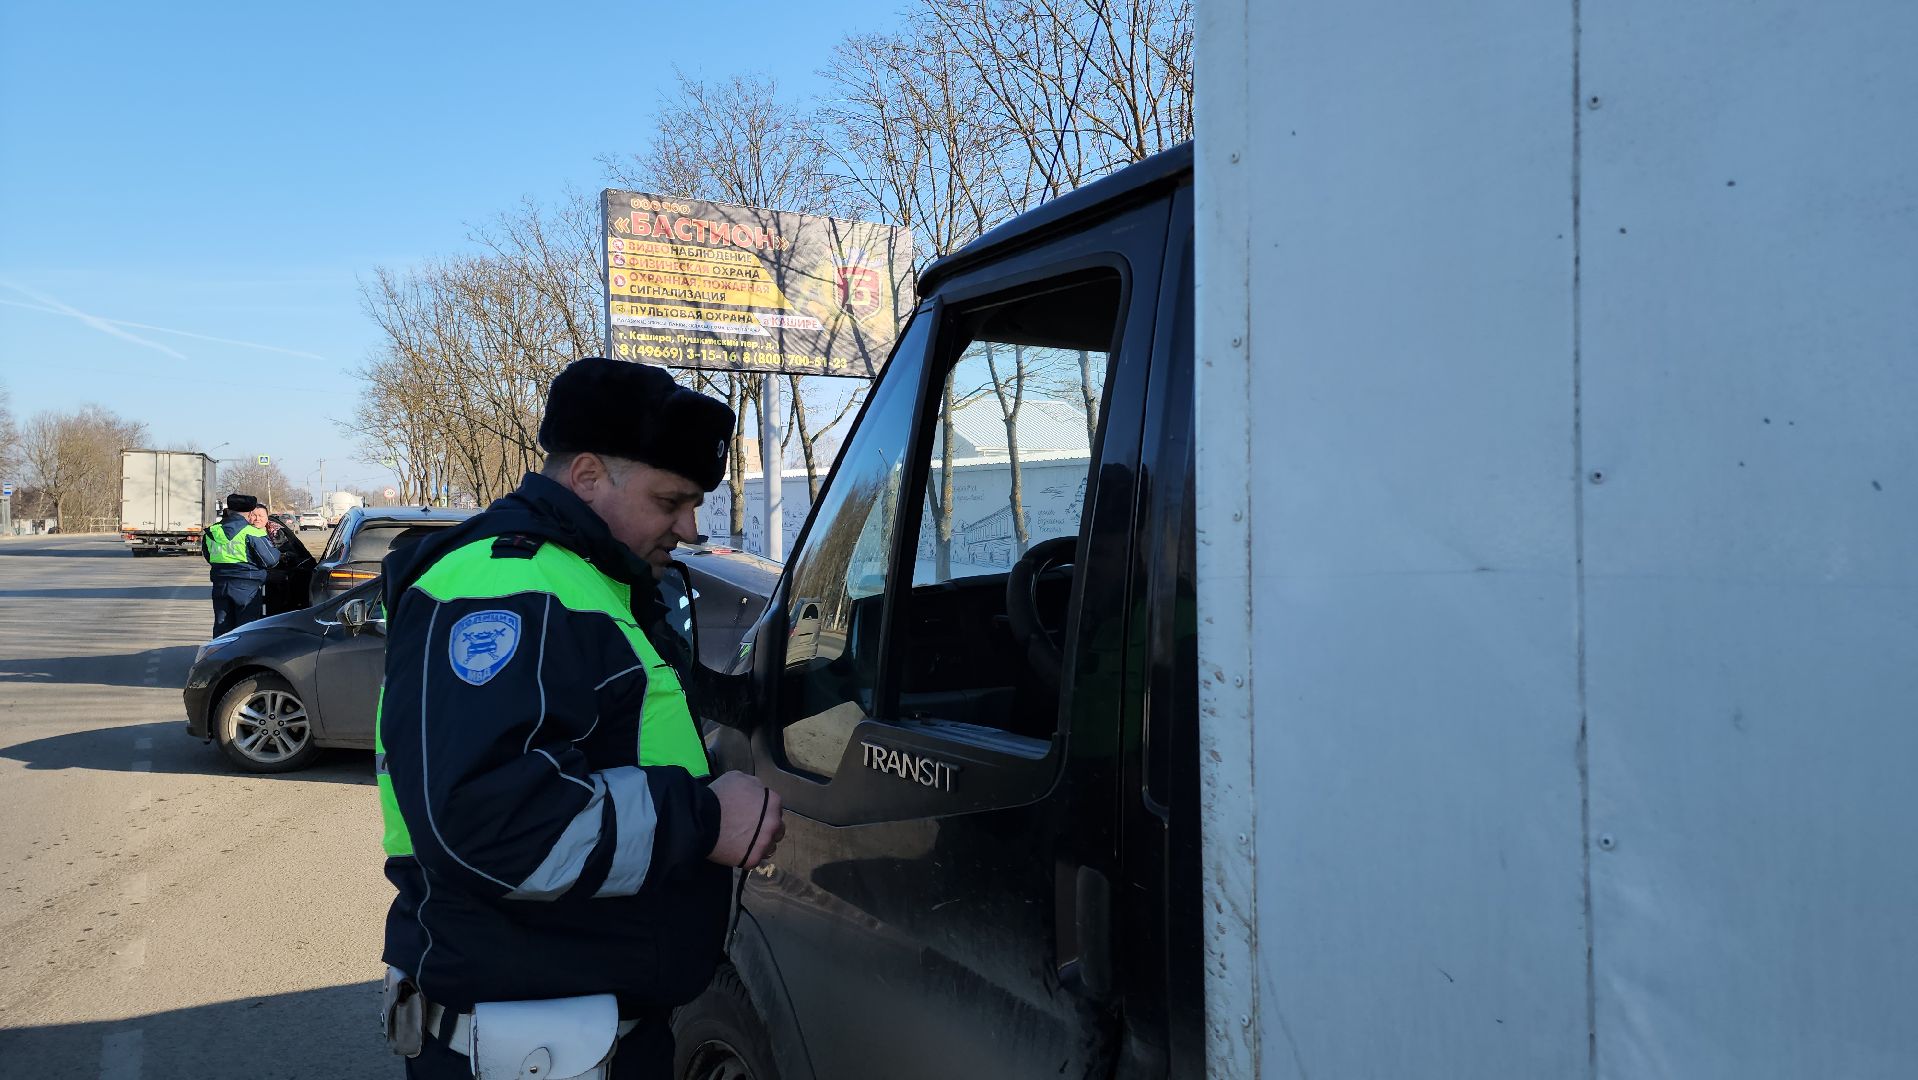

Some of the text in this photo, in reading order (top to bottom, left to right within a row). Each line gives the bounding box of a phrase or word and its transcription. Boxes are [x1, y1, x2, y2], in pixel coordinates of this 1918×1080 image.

[613, 211, 790, 252] «БАСТИОН»
[629, 257, 760, 280] ФИЗИЧЕСКАЯ ОХРАНА
[629, 284, 726, 302] СИГНАЛИЗАЦИЯ
[703, 279, 770, 294] ПОЖАРНАЯ
[630, 305, 703, 320] ПУЛЬТОВАЯ
[705, 311, 754, 325] ОХРАНА
[771, 316, 818, 329] КАШИРЕ
[629, 330, 675, 344] Кашира,
[677, 334, 739, 347] Пушкинский
[619, 343, 629, 356] 8
[632, 344, 683, 362] (49669)
[686, 347, 737, 363] 3-15-16
[742, 351, 751, 364] 8
[753, 351, 785, 368] (800)
[860, 741, 959, 793] TRANSIT
